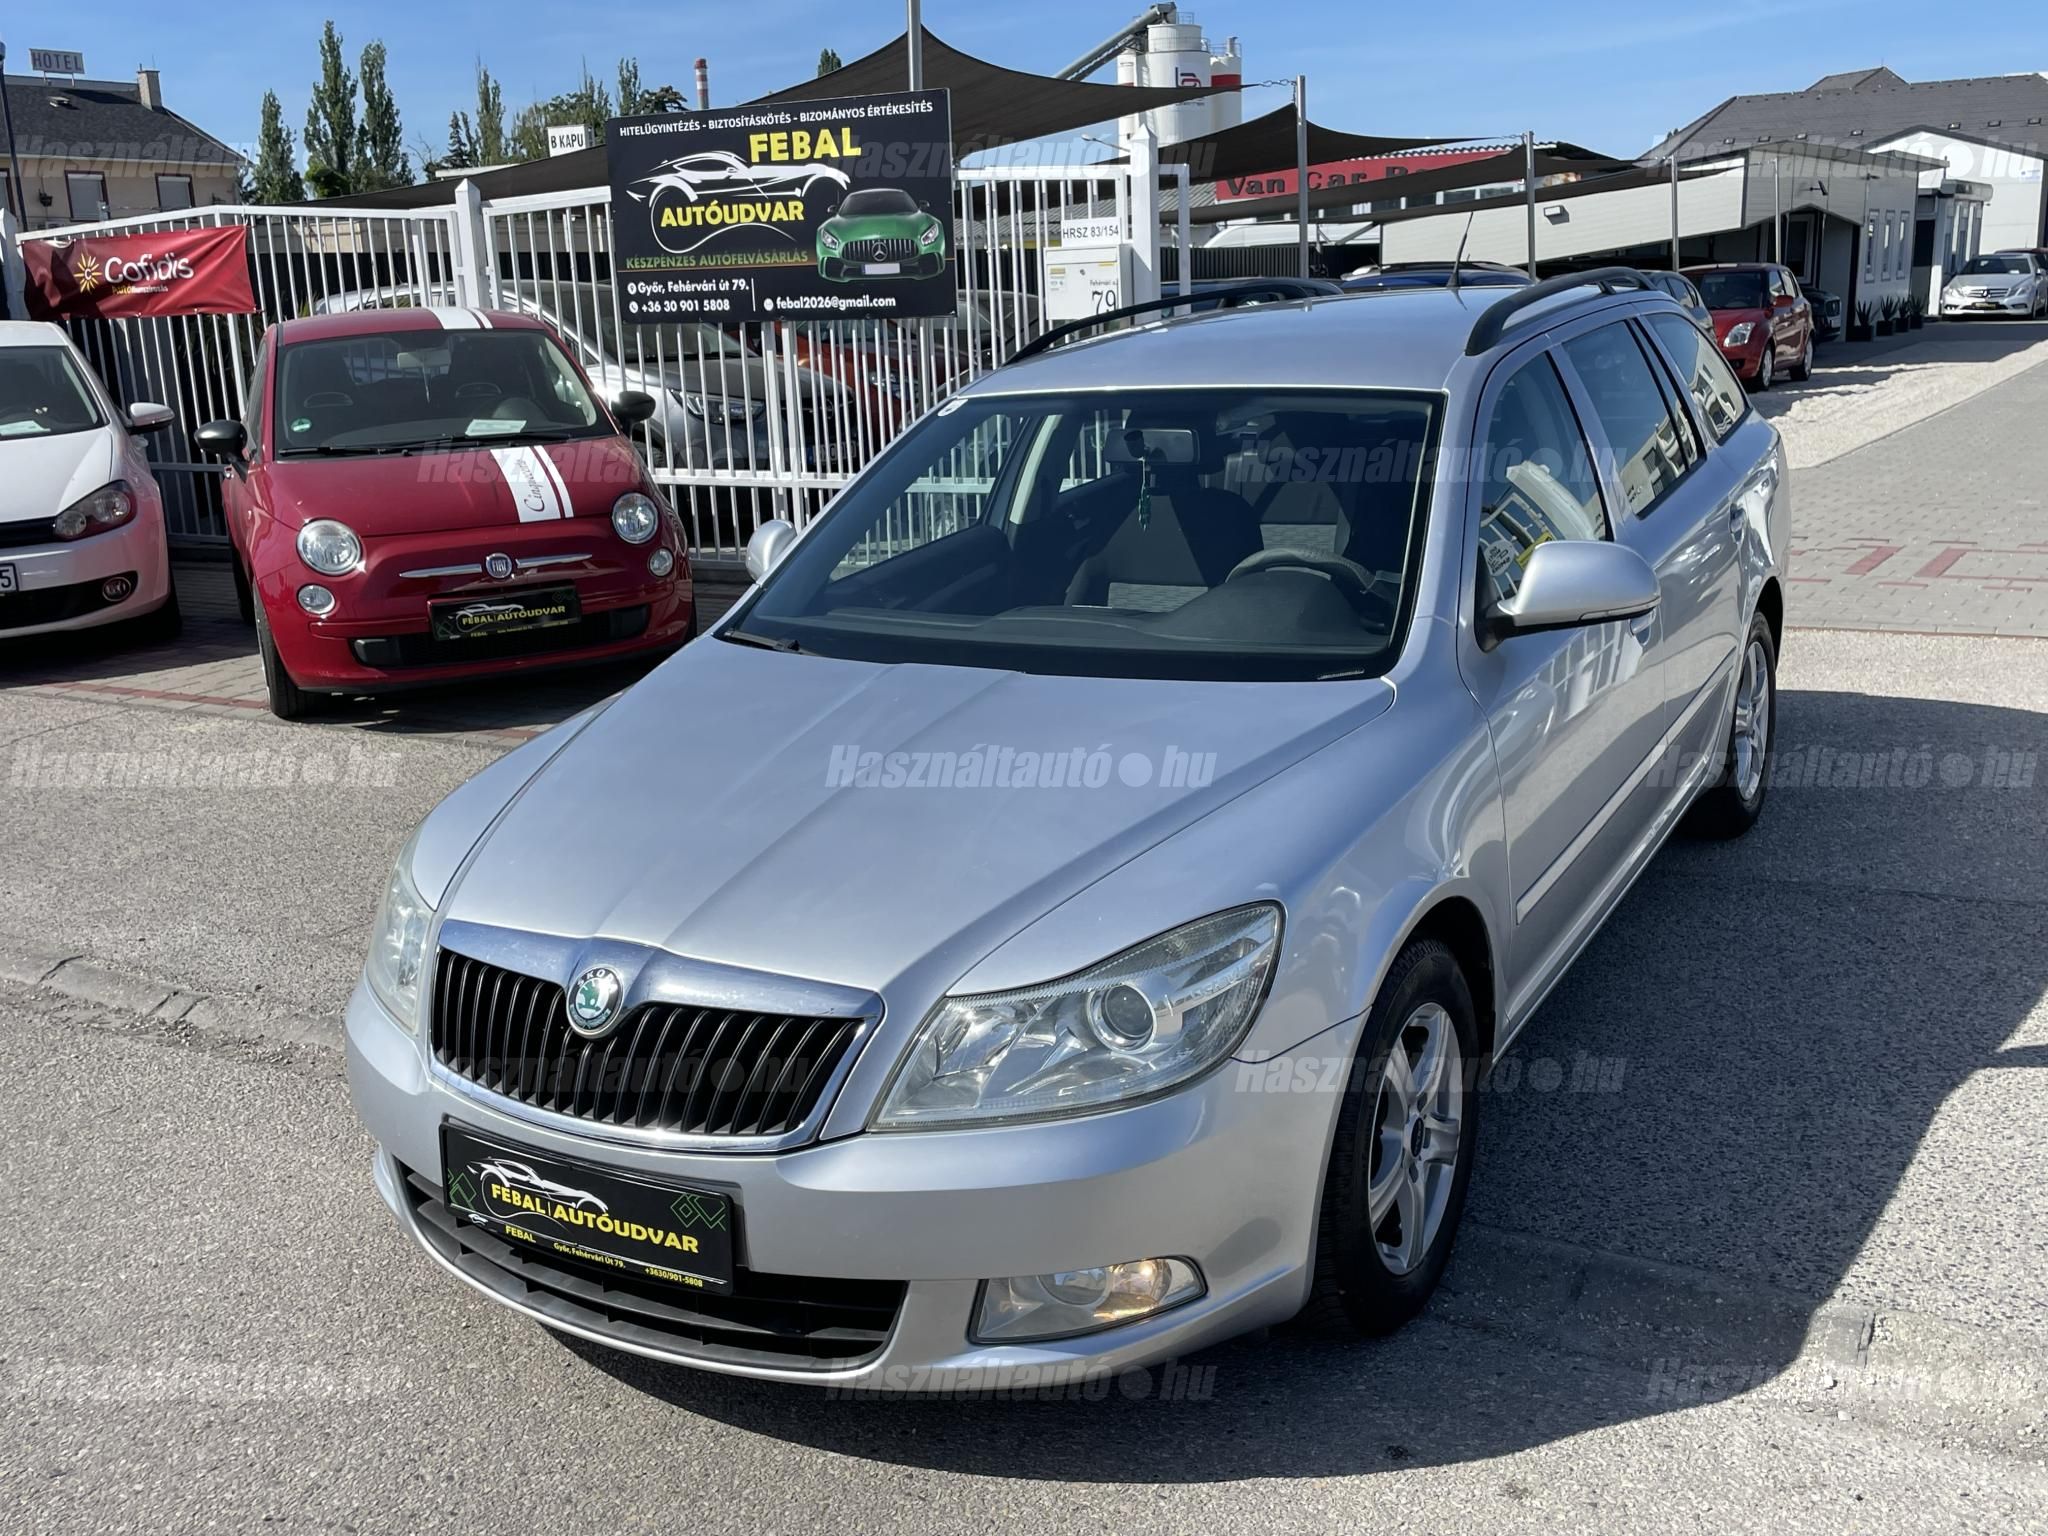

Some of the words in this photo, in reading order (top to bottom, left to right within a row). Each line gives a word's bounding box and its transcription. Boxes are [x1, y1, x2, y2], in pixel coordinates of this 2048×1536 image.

[32, 52, 81, 70] HOTEL
[619, 118, 700, 136] HITELÜGYINTÉZÉS
[708, 111, 791, 130] BIZTOSÍTÁSKÖTÉS
[800, 107, 866, 122] BIZOMÁNYOS
[867, 100, 933, 117] ÉRTÉKESÍTÉS
[550, 135, 557, 148] B
[559, 133, 584, 148] KAPU
[749, 127, 862, 163] FEBAL
[1225, 175, 1286, 197] Van
[1307, 170, 1368, 191] Car
[660, 200, 805, 228] AUTÓUDVAR
[1063, 226, 1088, 239] HRSZ
[1090, 225, 1119, 238] 83/154
[104, 252, 194, 283] Cofidis
[626, 254, 697, 270] KÉSZPÉNZES
[667, 278, 717, 293] Fehérvári
[718, 279, 730, 291] út
[731, 278, 750, 291] 79.
[641, 300, 661, 313] +36
[663, 300, 678, 312] 30
[679, 299, 699, 311] 901
[703, 298, 730, 311] 5808
[776, 295, 896, 310] febal2026@gmail.com
[0, 569, 12, 588] 5
[462, 615, 494, 625] FEBAL
[497, 605, 566, 621] AUTÓUDVAR
[491, 1183, 546, 1214] FEBAL
[553, 1204, 699, 1253] AUTÓUDVAR
[505, 1224, 537, 1243] FEBAL
